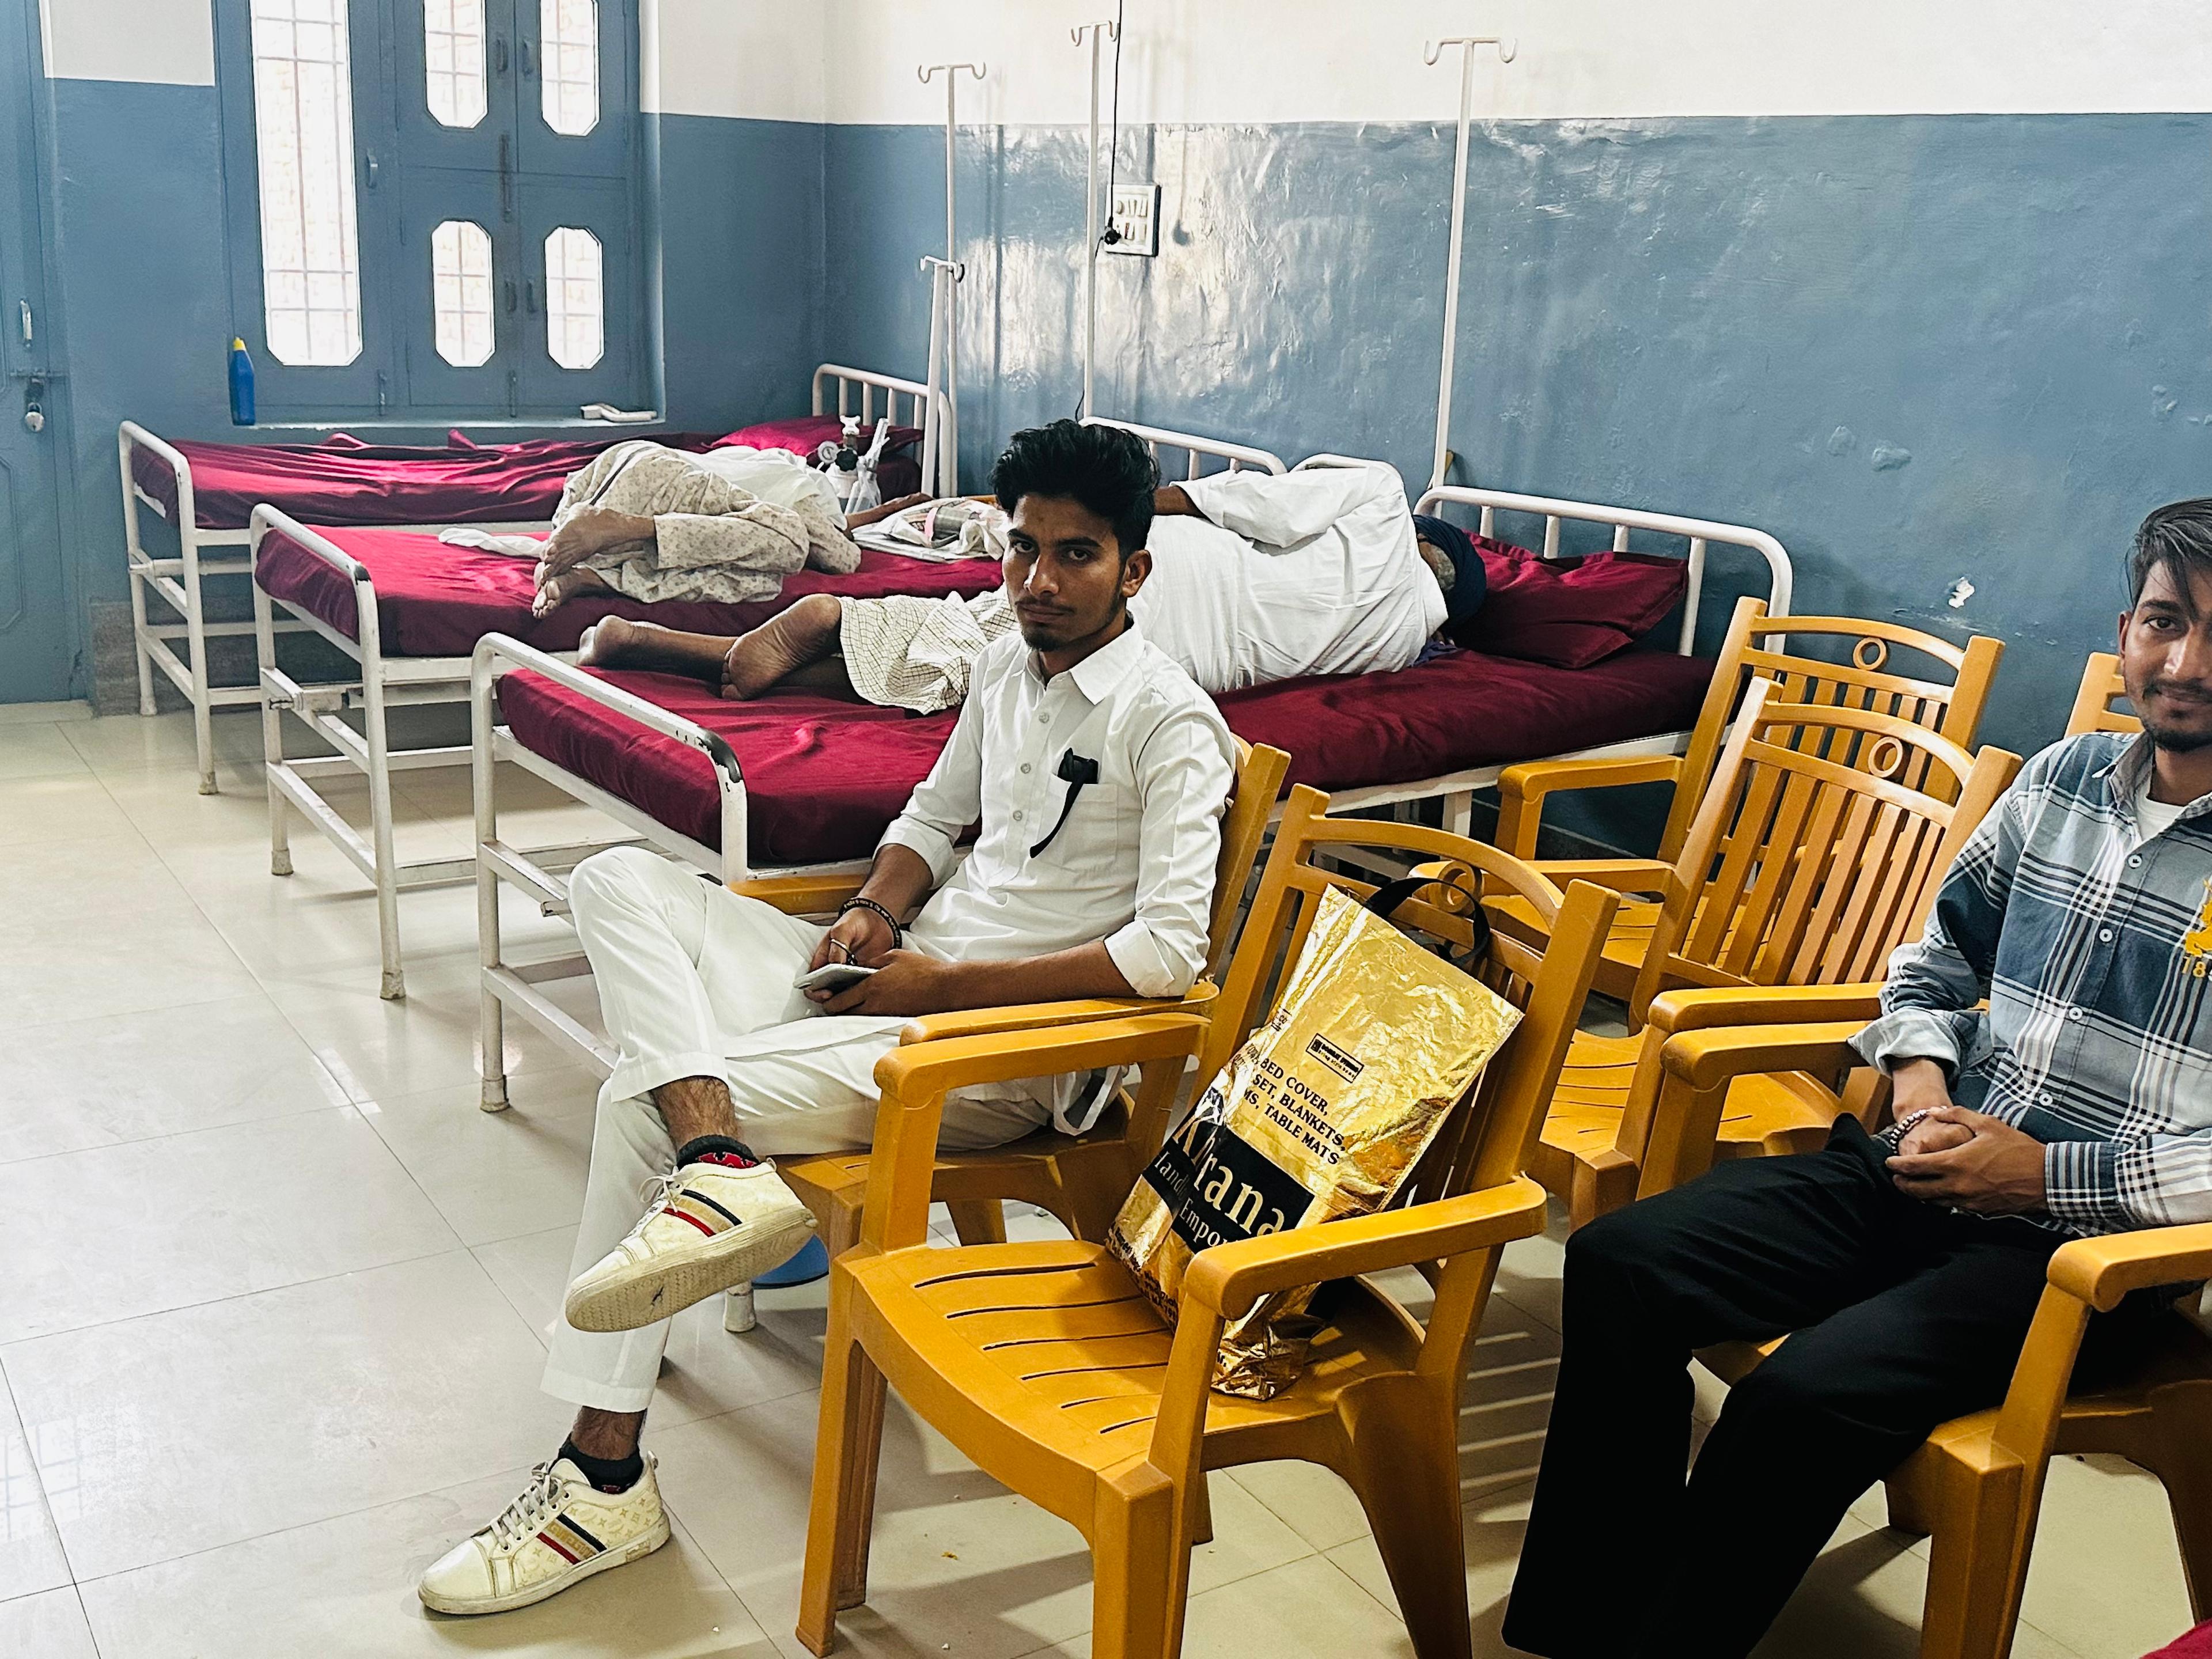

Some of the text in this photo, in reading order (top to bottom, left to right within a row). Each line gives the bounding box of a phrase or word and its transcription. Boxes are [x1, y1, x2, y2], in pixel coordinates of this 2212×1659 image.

[1252, 1073, 1346, 1152] SET, BLANKETS,
[1260, 1058, 1284, 1080] BED
[1286, 1077, 1328, 1116] COVER,
[1243, 1088, 1340, 1165] MS, TABLE MATS
